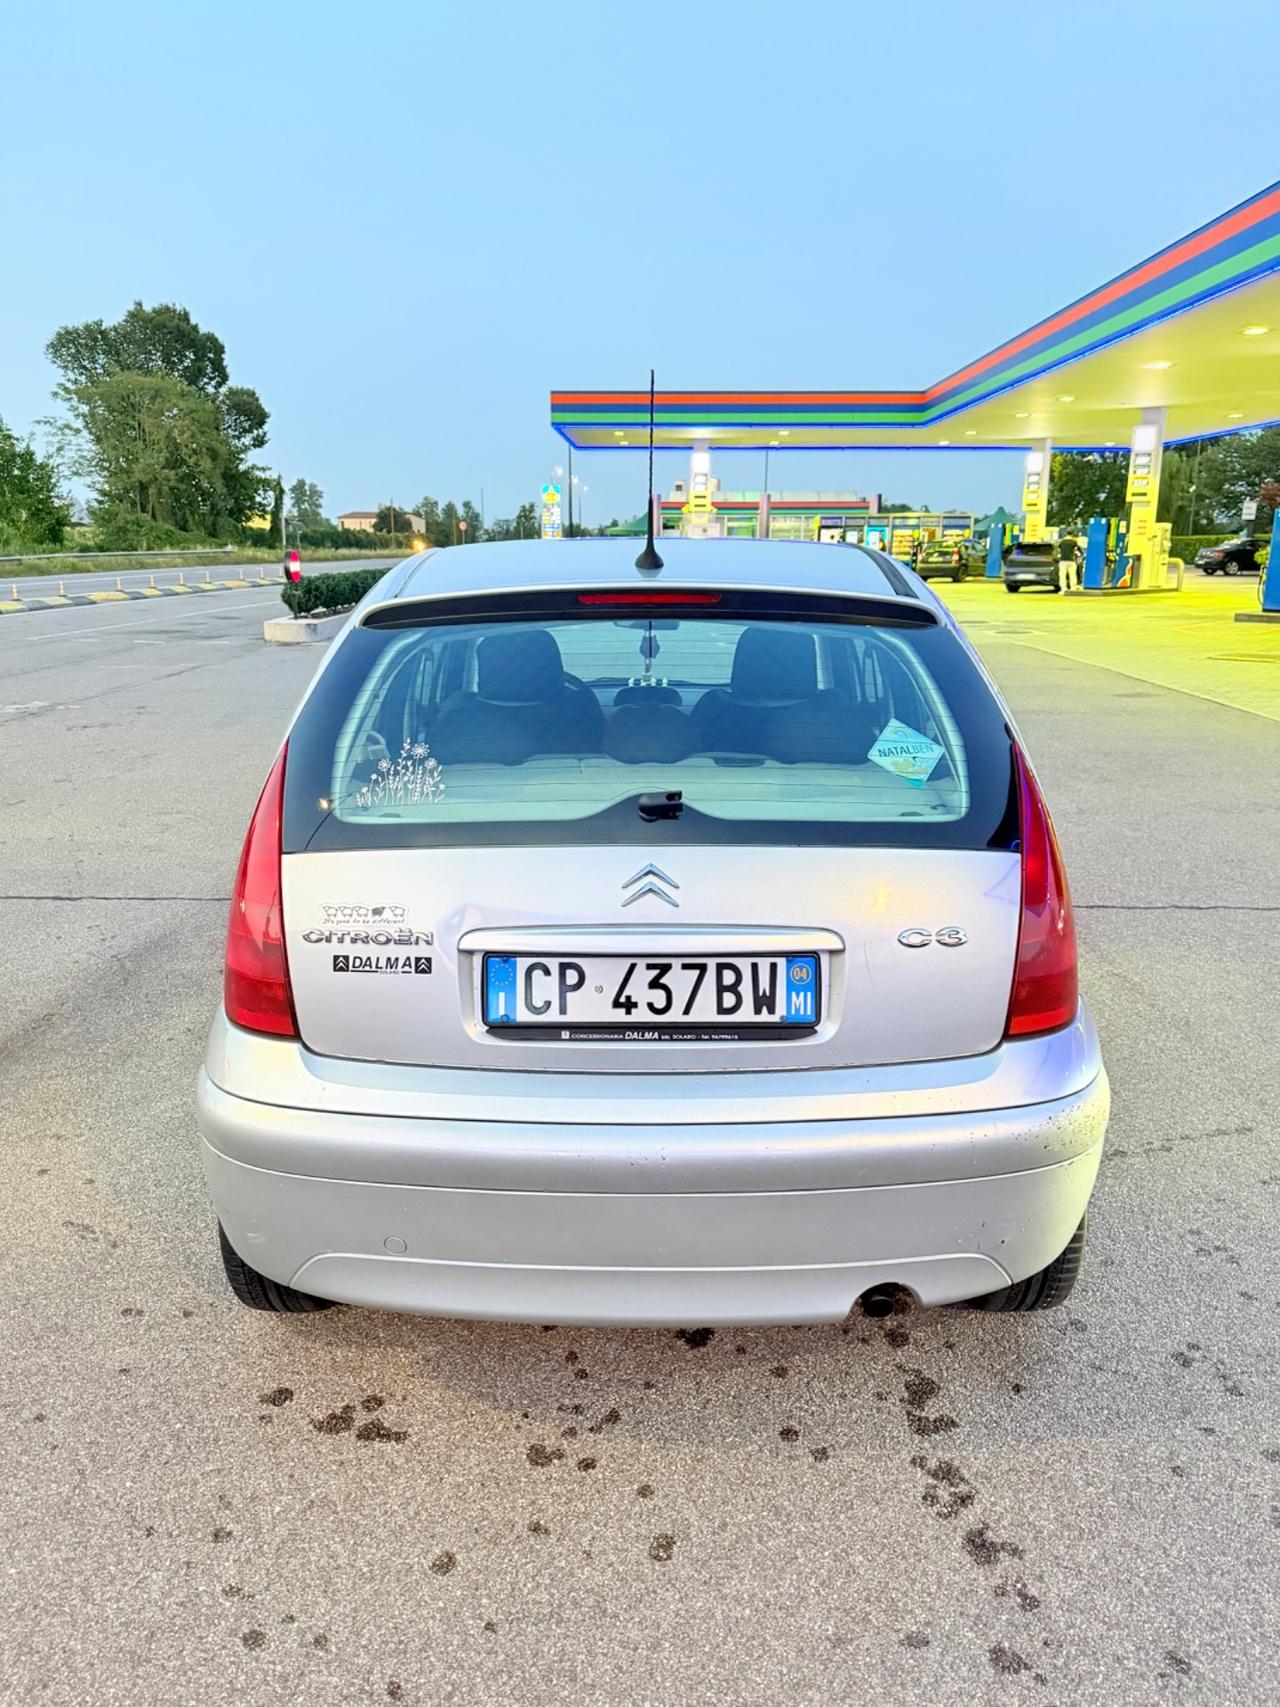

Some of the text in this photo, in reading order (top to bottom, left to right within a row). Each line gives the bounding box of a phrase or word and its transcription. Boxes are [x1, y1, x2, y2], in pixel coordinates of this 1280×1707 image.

[877, 743, 934, 758] NATALBEN
[302, 927, 434, 946] CITROËN
[897, 926, 968, 948] C3
[352, 956, 412, 970] DALMA
[792, 968, 809, 981] 04
[523, 961, 779, 1016] CP 437BW
[791, 991, 812, 1015] MI
[625, 1031, 659, 1040] DALMA
